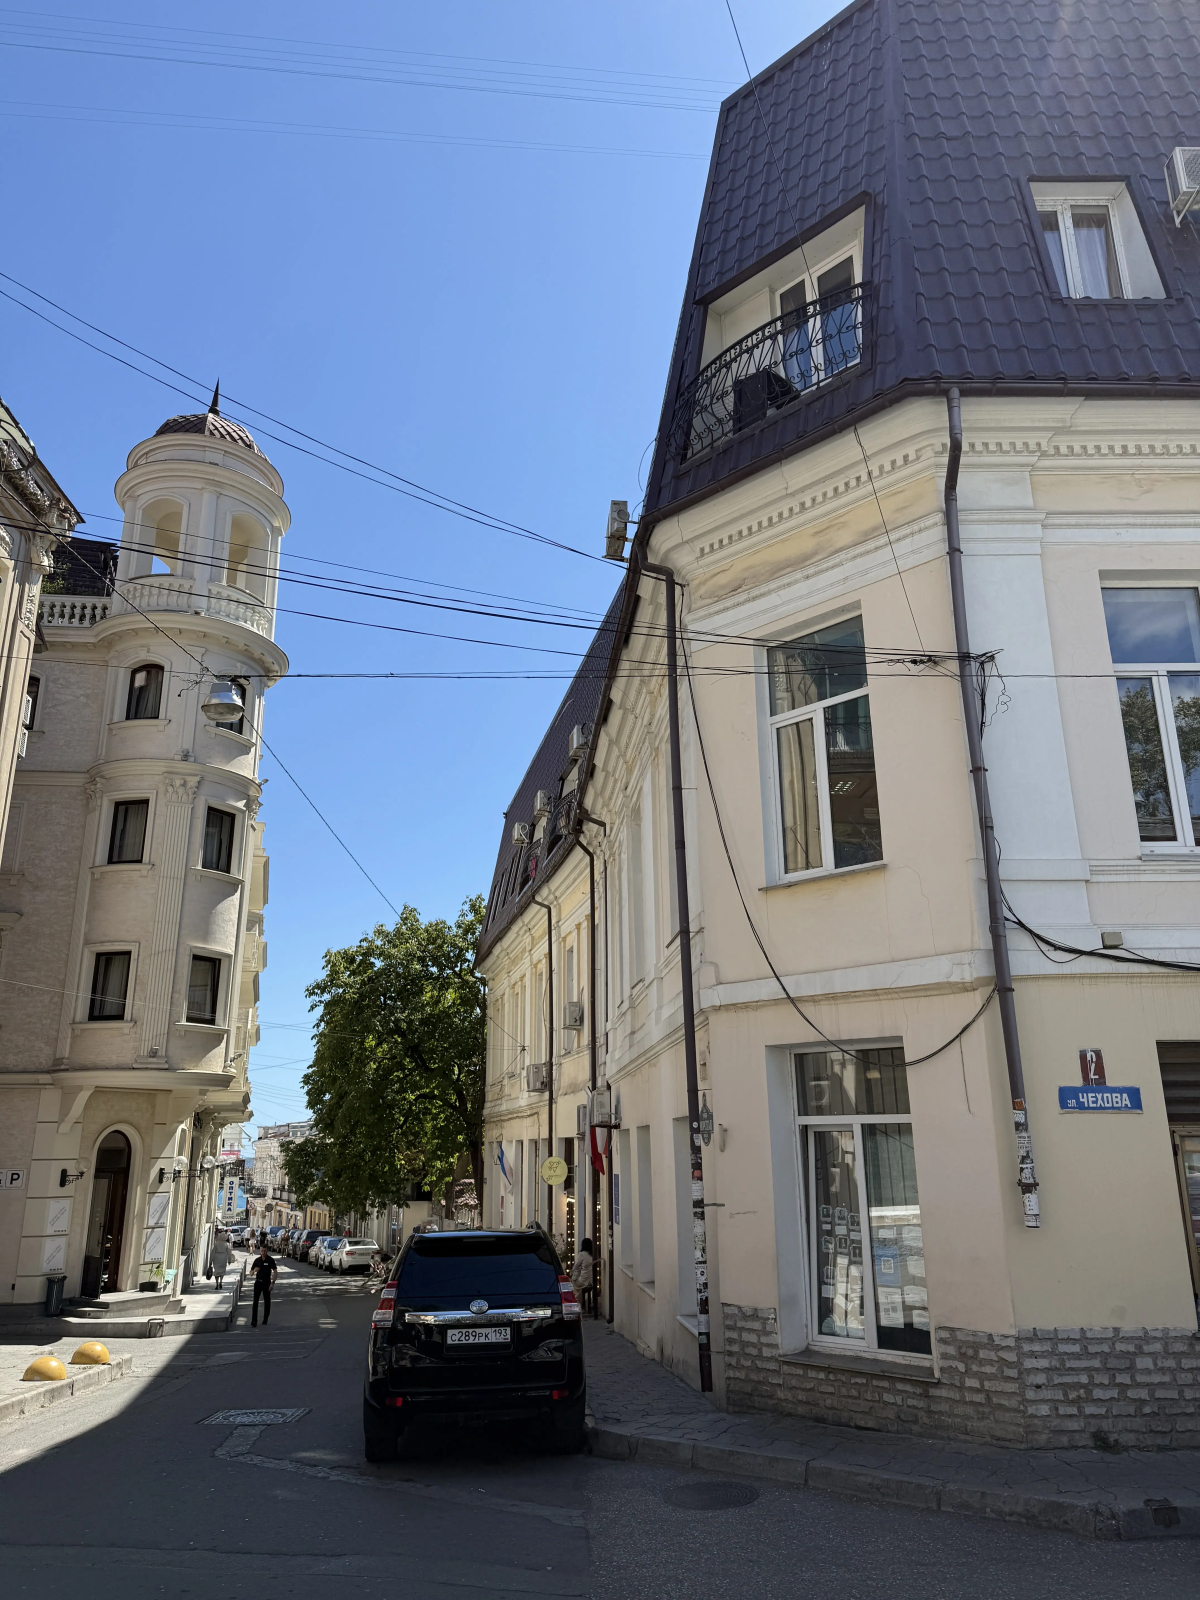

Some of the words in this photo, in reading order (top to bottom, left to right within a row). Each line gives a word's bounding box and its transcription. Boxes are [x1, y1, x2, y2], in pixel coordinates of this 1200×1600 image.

[1079, 1093, 1131, 1107] ЧЕХОВА
[226, 1180, 234, 1212] ОПТИКА
[492, 1329, 508, 1337] 193
